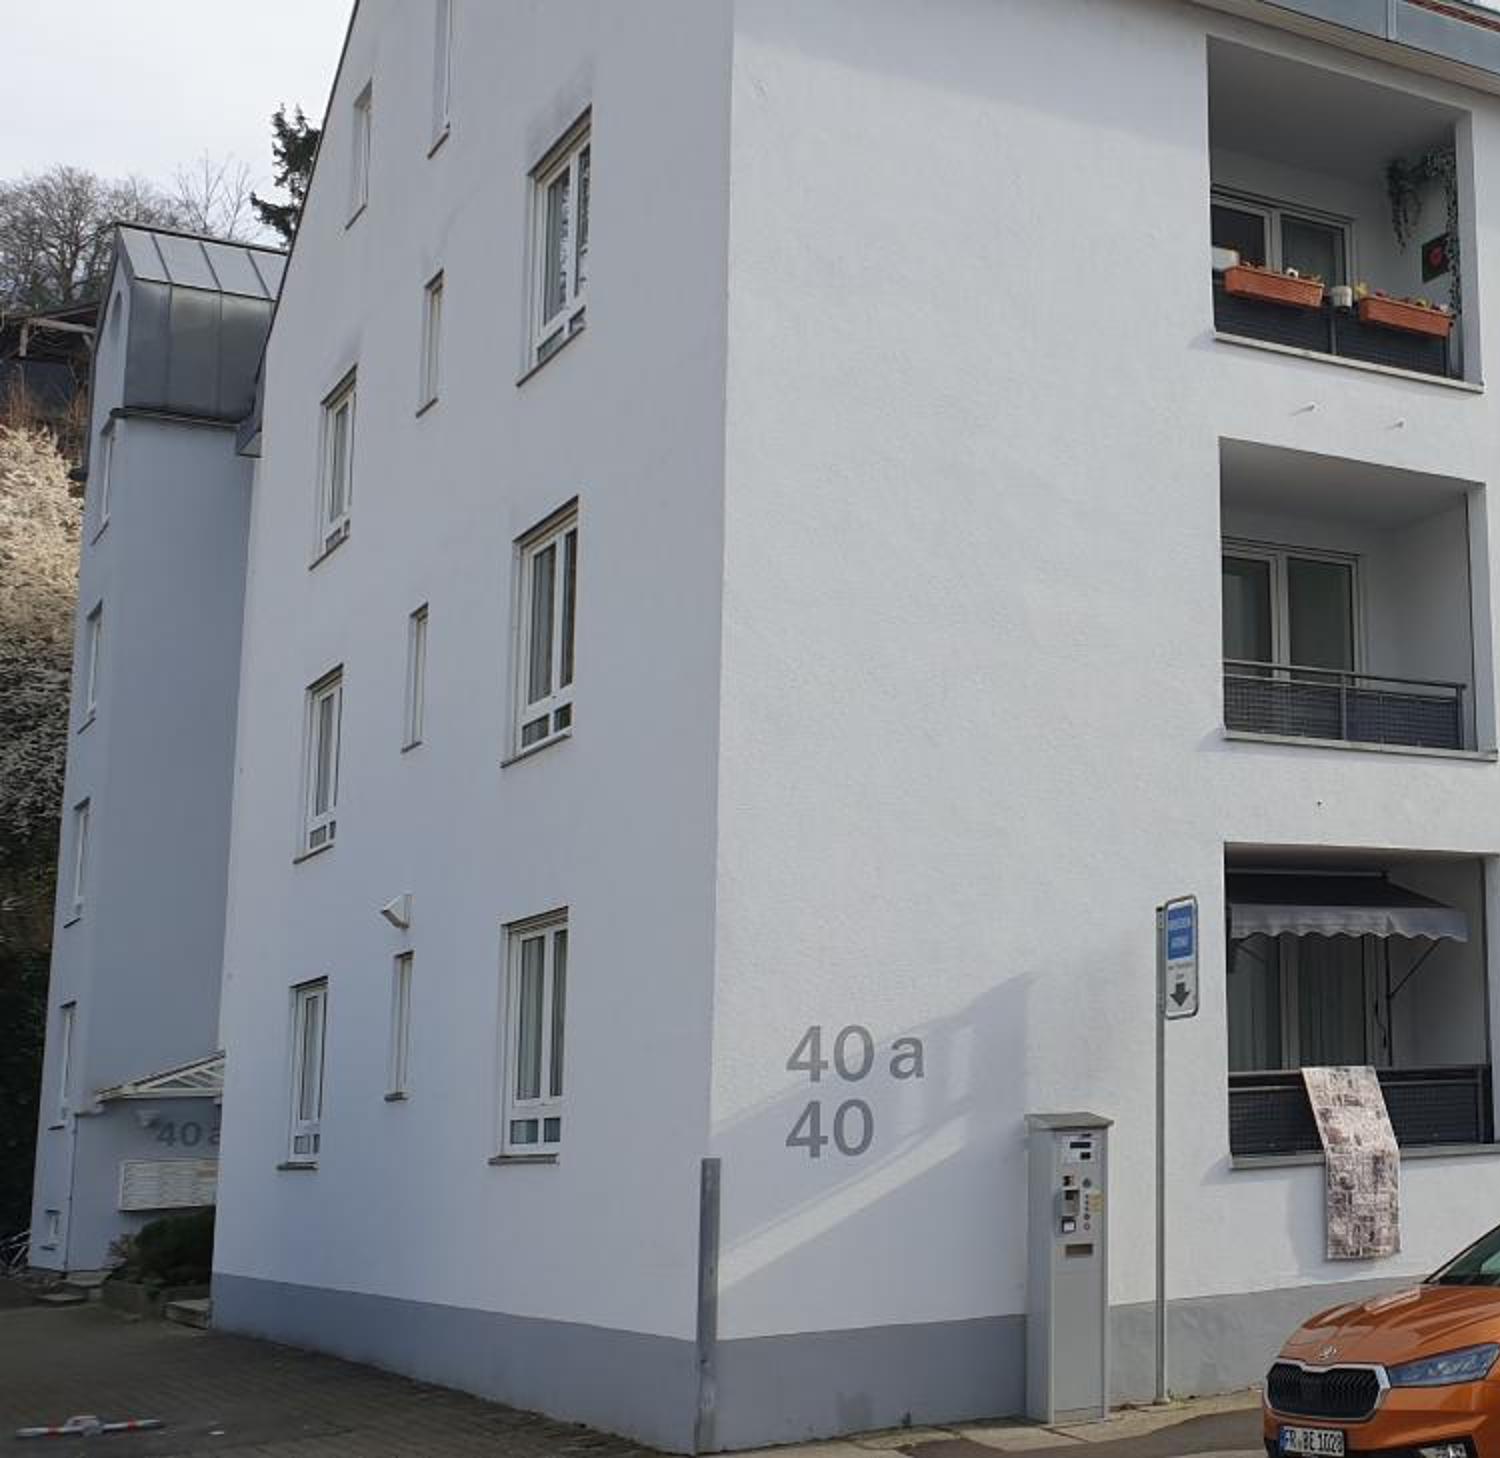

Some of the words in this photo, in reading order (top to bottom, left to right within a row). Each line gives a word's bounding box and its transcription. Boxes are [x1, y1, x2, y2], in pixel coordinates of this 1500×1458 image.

[785, 1024, 875, 1083] 40
[889, 1037, 924, 1080] a
[157, 1121, 203, 1147] 40
[785, 1099, 874, 1158] 40
